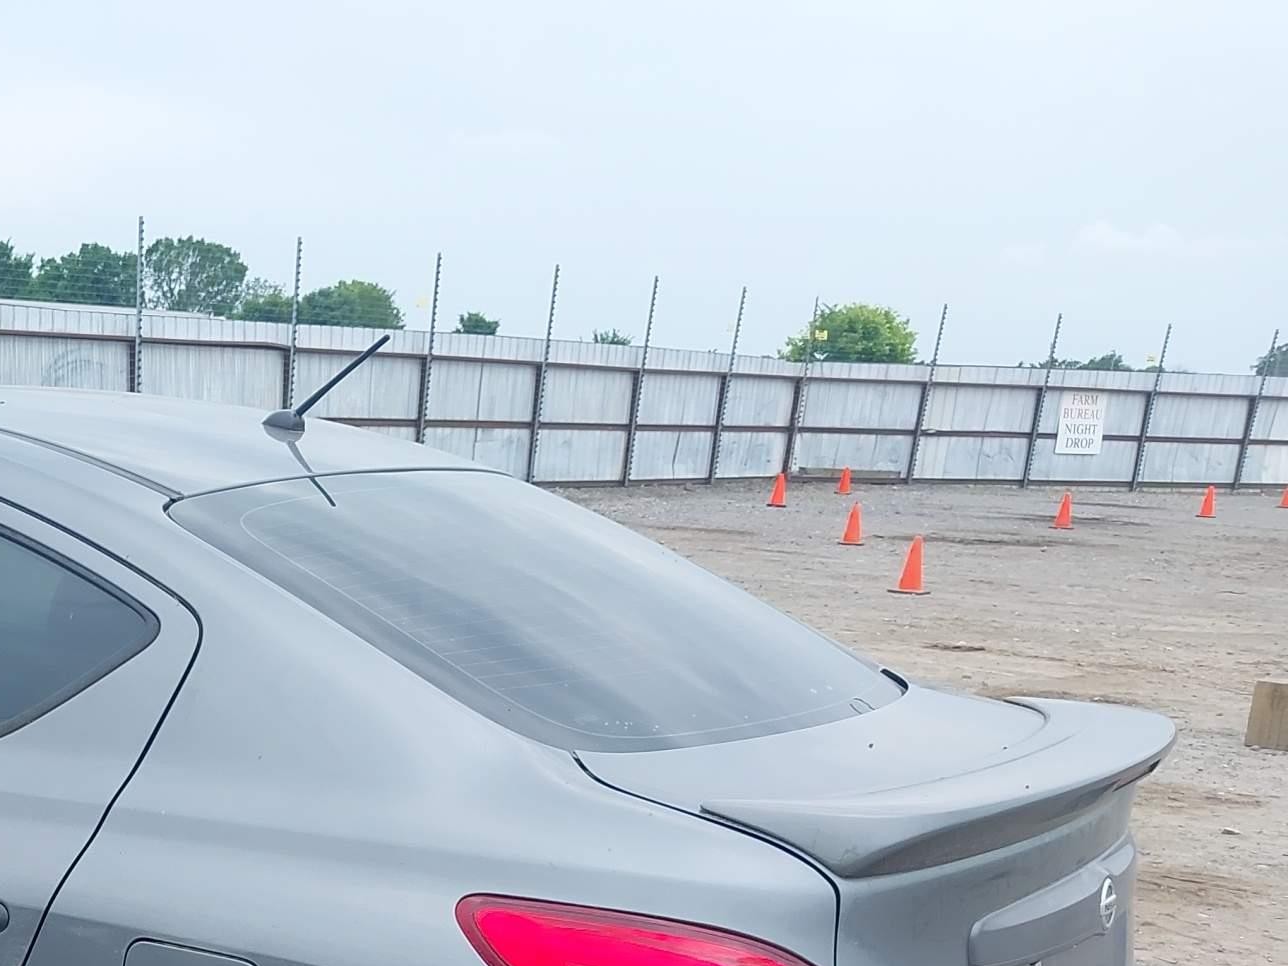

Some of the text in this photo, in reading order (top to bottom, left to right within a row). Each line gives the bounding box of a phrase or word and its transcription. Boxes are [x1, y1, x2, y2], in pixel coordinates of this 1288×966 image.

[1072, 393, 1099, 406] FARM
[1063, 407, 1102, 420] BUREAU
[1065, 423, 1098, 435] NIGHT
[1065, 437, 1094, 449] DROP
